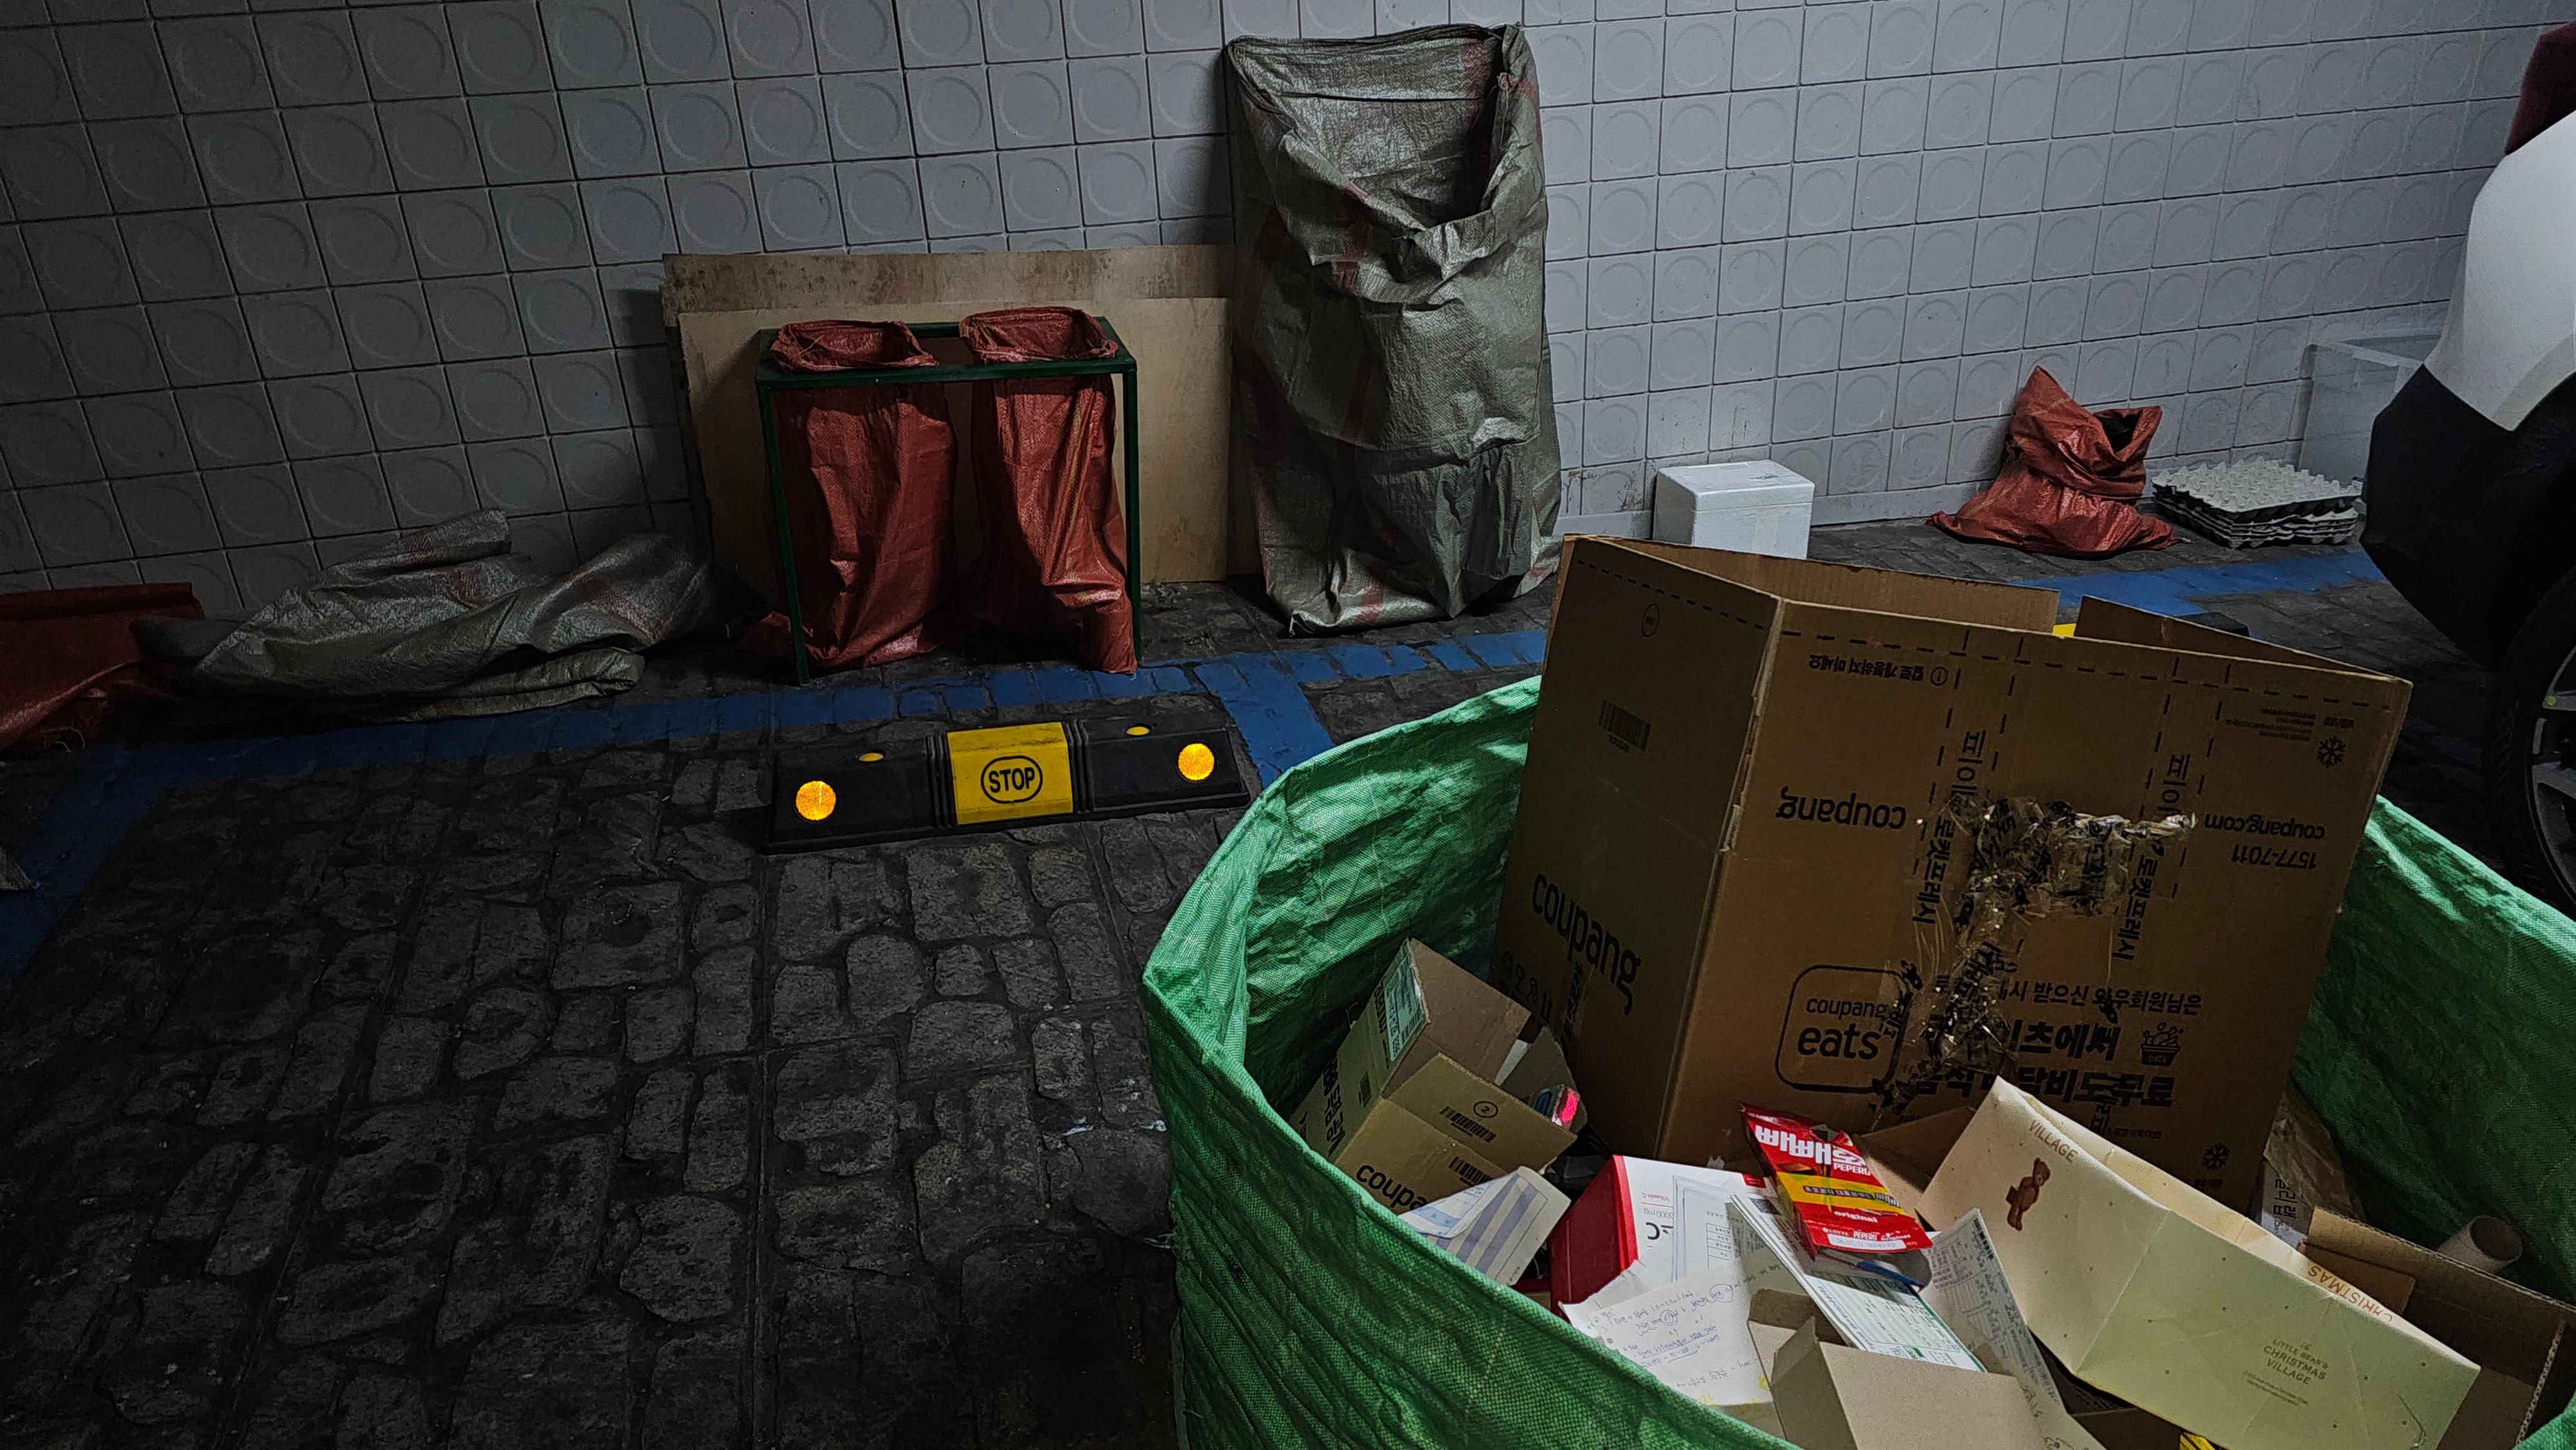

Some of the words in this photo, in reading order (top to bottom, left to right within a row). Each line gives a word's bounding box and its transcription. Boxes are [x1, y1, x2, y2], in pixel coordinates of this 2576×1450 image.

[1809, 654, 1846, 674] 마세요
[988, 767, 1036, 793] STOP
[1776, 786, 1908, 831] coupang
[2204, 813, 2326, 841] coupang.com
[1912, 814, 1955, 924] 로켓프레시
[2232, 842, 2317, 870] 1577-7011
[2112, 856, 2158, 961] 로켓프레시
[1531, 872, 1641, 1017] coupang
[2032, 981, 2090, 1006] 받으신
[1805, 996, 1889, 1024] coupang
[1796, 1024, 1880, 1061] eats
[2029, 1118, 2078, 1163] VILLAGE
[1647, 1193, 1670, 1202] Vitamin
[1833, 1209, 1879, 1224] original
[1853, 1229, 1878, 1242] PEPERO
[2307, 1264, 2394, 1323] CHRISTMAS
[2264, 1345, 2327, 1380] CHRISTMAS
[2272, 1337, 2298, 1355] LITTLE
[2300, 1351, 2329, 1370] BEAR'S
[2267, 1357, 2312, 1385] VILLAGE
